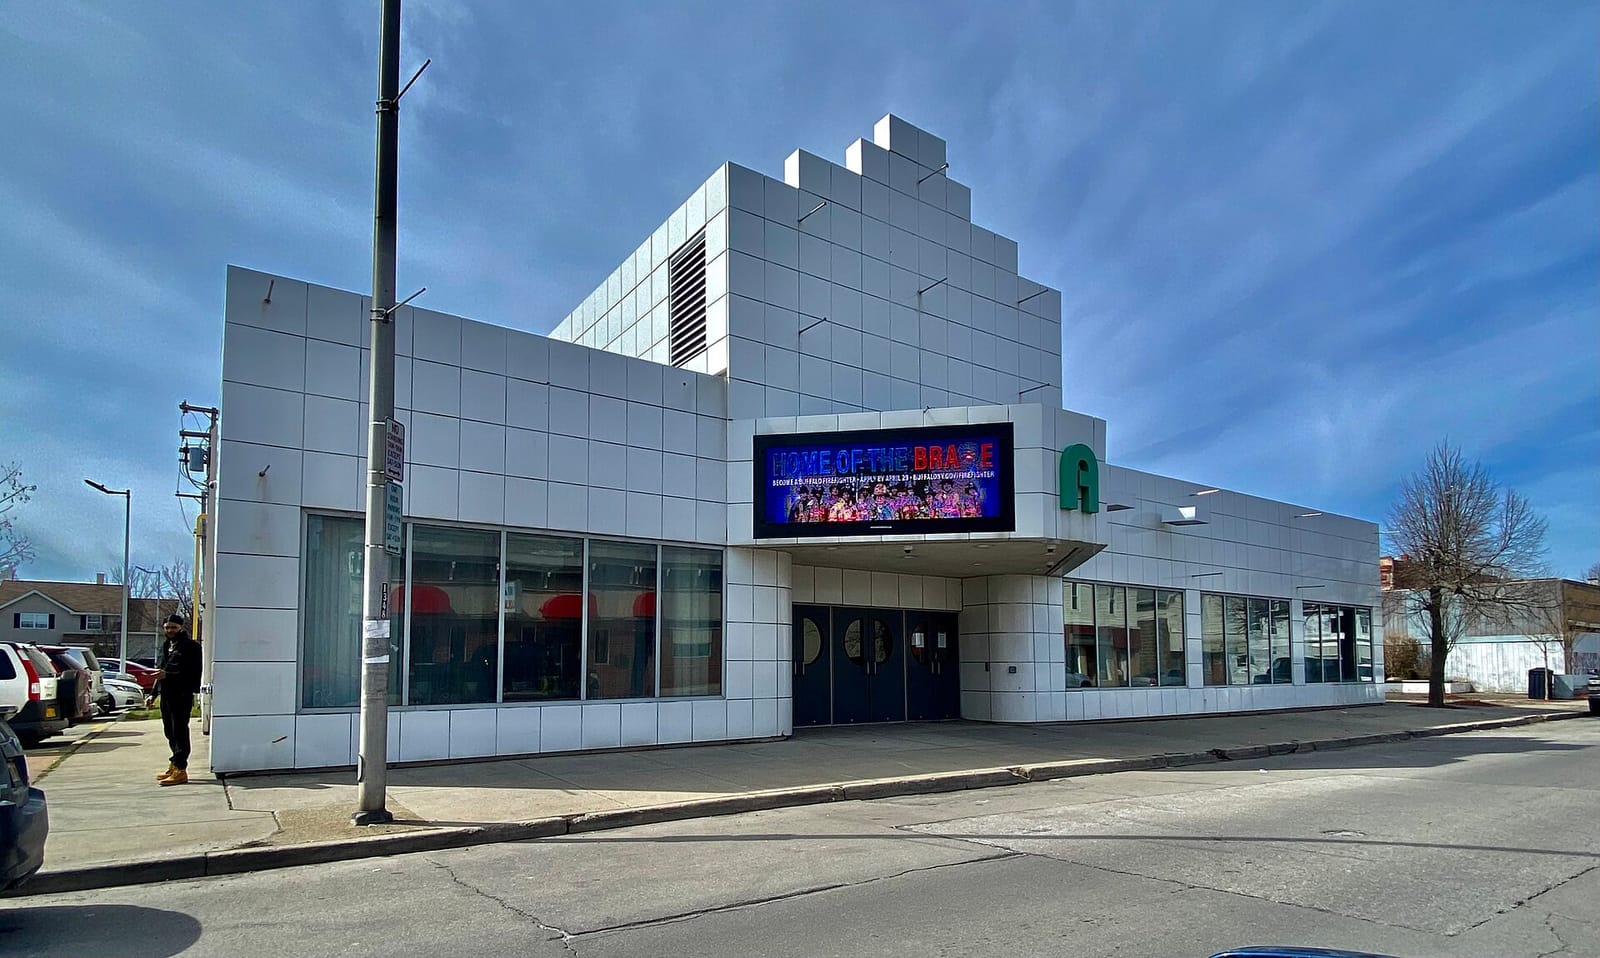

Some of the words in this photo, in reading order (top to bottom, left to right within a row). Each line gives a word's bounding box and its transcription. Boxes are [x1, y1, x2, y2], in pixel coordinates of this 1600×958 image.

[772, 451, 831, 476] HOME
[836, 450, 863, 474] OF
[867, 447, 909, 473] THE
[913, 443, 994, 471] BRAE
